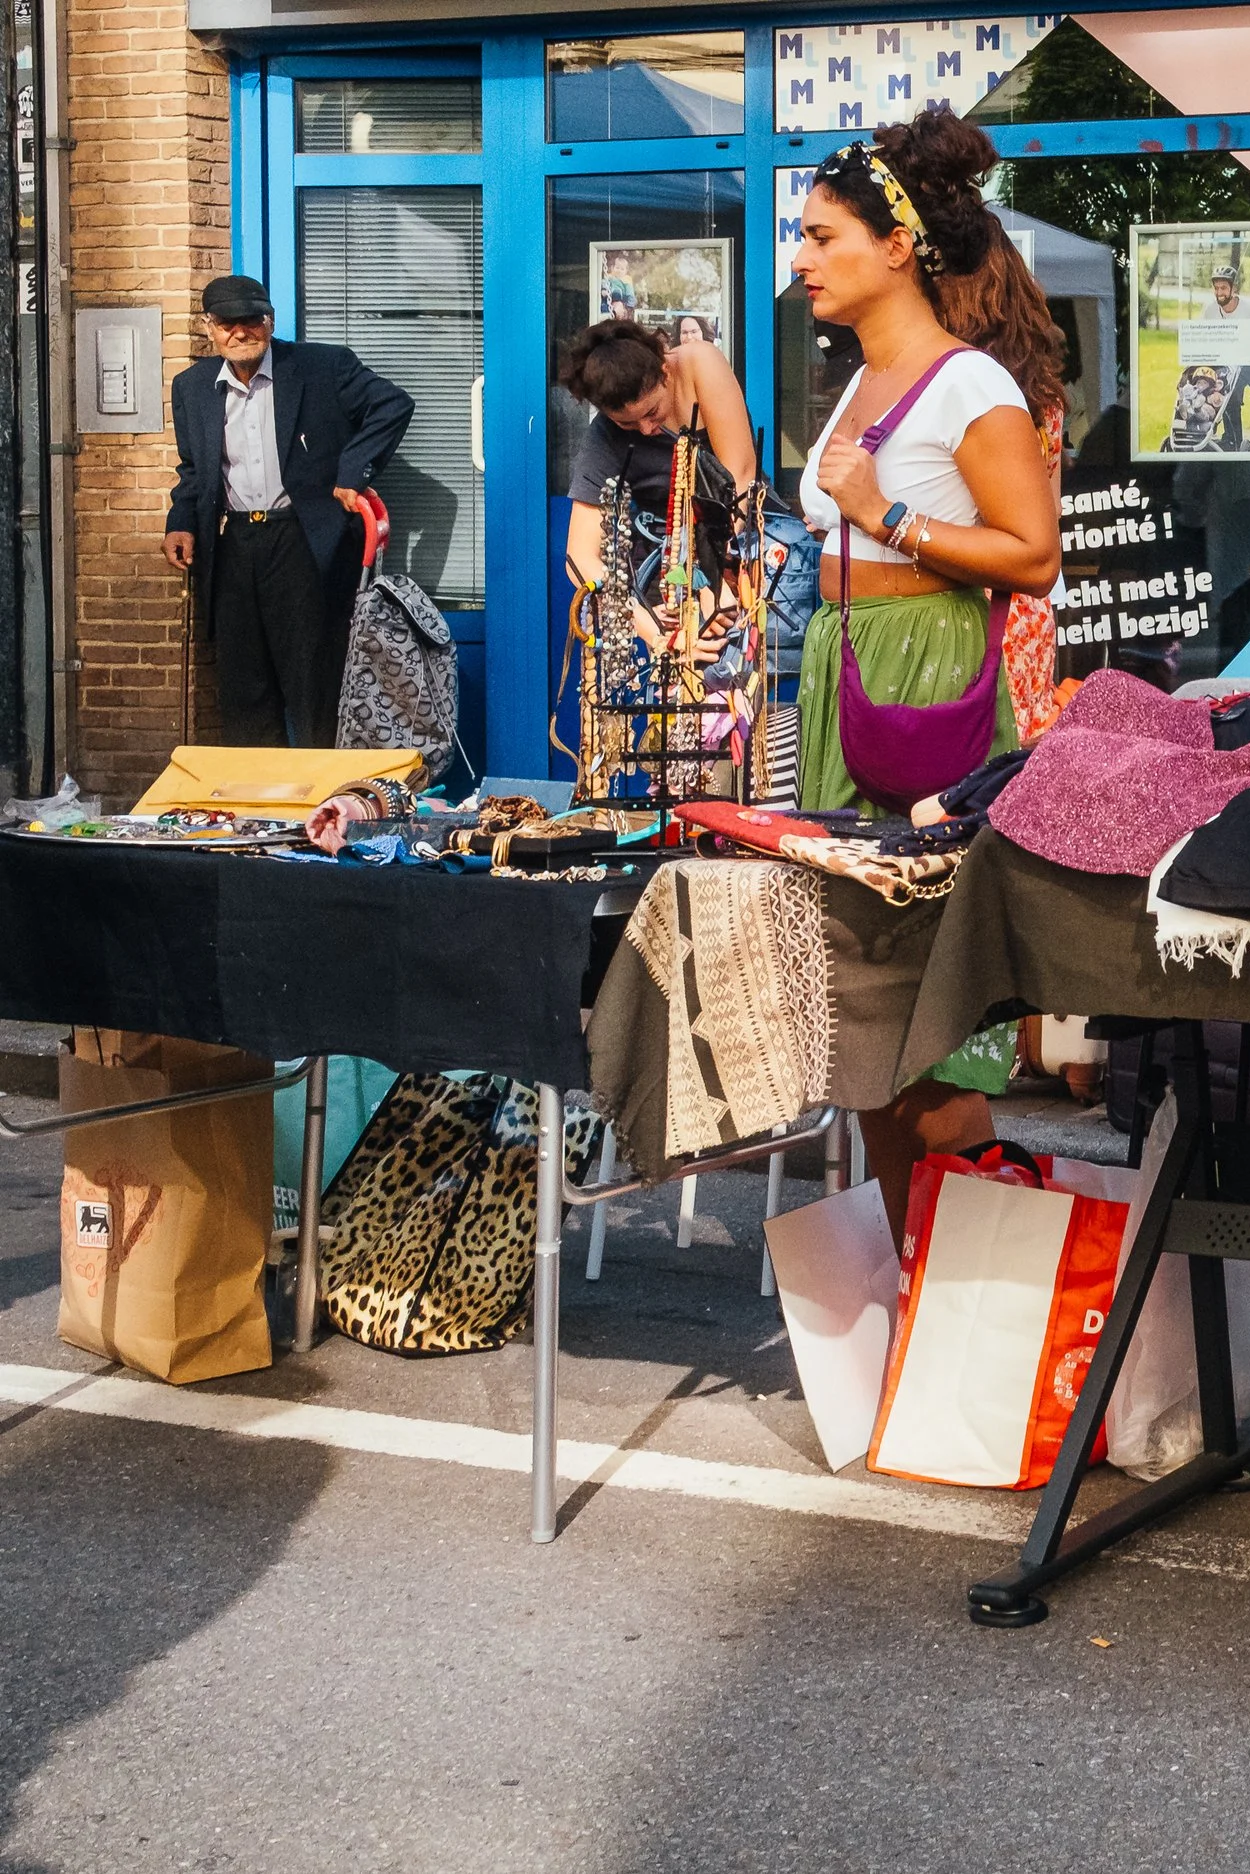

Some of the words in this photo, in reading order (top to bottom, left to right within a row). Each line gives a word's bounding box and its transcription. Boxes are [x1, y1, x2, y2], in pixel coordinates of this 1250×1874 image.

[780, 33, 802, 59] M
[876, 28, 900, 54] M
[976, 24, 1000, 50] M
[828, 56, 851, 82] M
[937, 51, 961, 77] M
[791, 79, 813, 104] M
[888, 74, 911, 99] M
[840, 102, 862, 127] M
[791, 171, 813, 195] M
[780, 218, 802, 242] M
[1060, 479, 1150, 516] santé,
[1061, 514, 1156, 552] riorité
[1163, 512, 1173, 539] !
[1057, 579, 1113, 610] cht
[1119, 571, 1178, 603] met
[1183, 567, 1213, 600] je
[1118, 602, 1209, 638] bezig!
[1083, 1308, 1109, 1334] D
